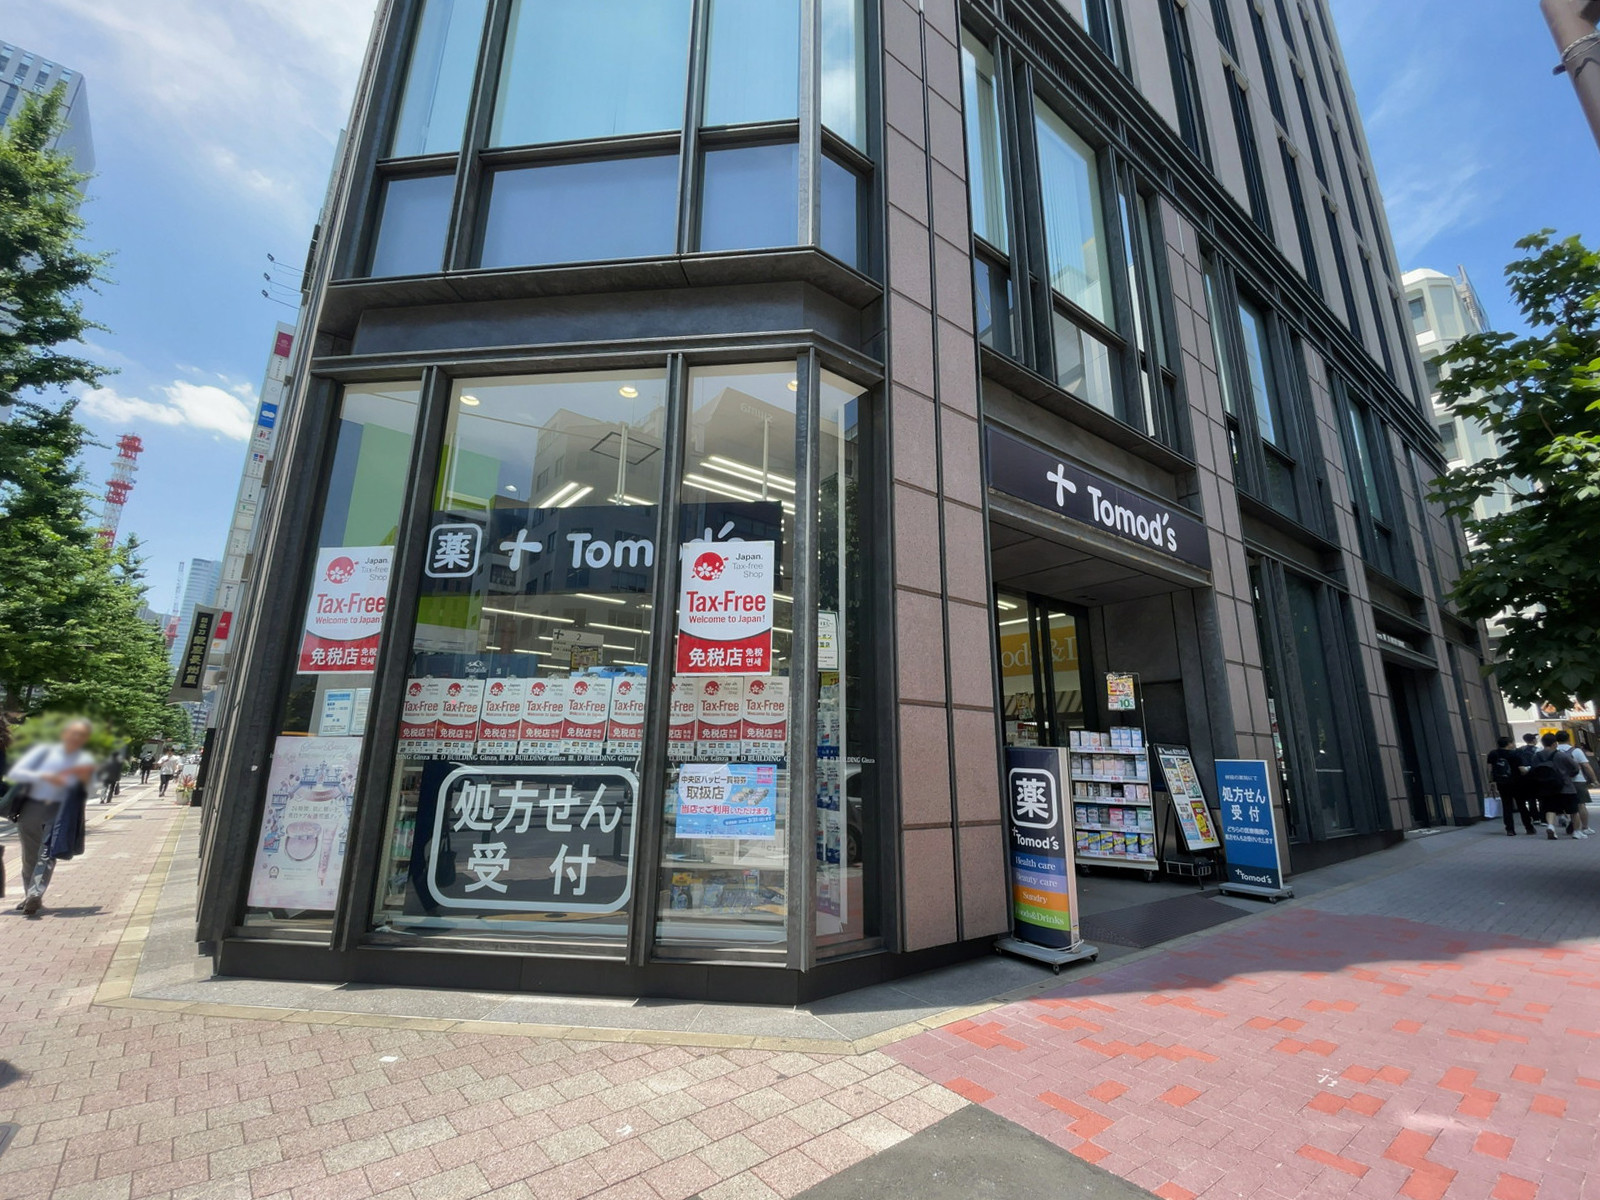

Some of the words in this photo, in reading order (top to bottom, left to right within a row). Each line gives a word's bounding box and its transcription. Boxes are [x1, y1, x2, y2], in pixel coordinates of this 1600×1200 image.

[1087, 485, 1177, 552] Tomod's
[433, 532, 472, 568] 薬
[732, 562, 763, 570] Tax-free
[317, 593, 386, 614] Tax-Free
[686, 590, 766, 612] Tax-Free
[316, 616, 348, 624] Welcome
[350, 616, 358, 624] to
[689, 616, 726, 624] Welcome
[310, 648, 359, 665] 免税店
[688, 648, 743, 667] 免税店
[404, 700, 438, 712] Tax-Free
[443, 700, 478, 713] Tax-Free
[486, 700, 520, 712] Tax-Free
[527, 700, 564, 712] Tax-Free
[569, 699, 606, 712] Tax-Free
[614, 700, 646, 711] Tax-Fre
[701, 700, 740, 711] Tax-Free
[746, 699, 784, 711] Tax-Free
[686, 786, 725, 800] 取扱店
[1016, 778, 1049, 818] 薬
[1222, 786, 1266, 804] 処方せん
[454, 780, 622, 834] 処方せん
[1016, 834, 1059, 850] Tomod's
[1016, 856, 1036, 868] Health
[1241, 874, 1272, 884] Tomod's
[1022, 891, 1048, 904] Sundry
